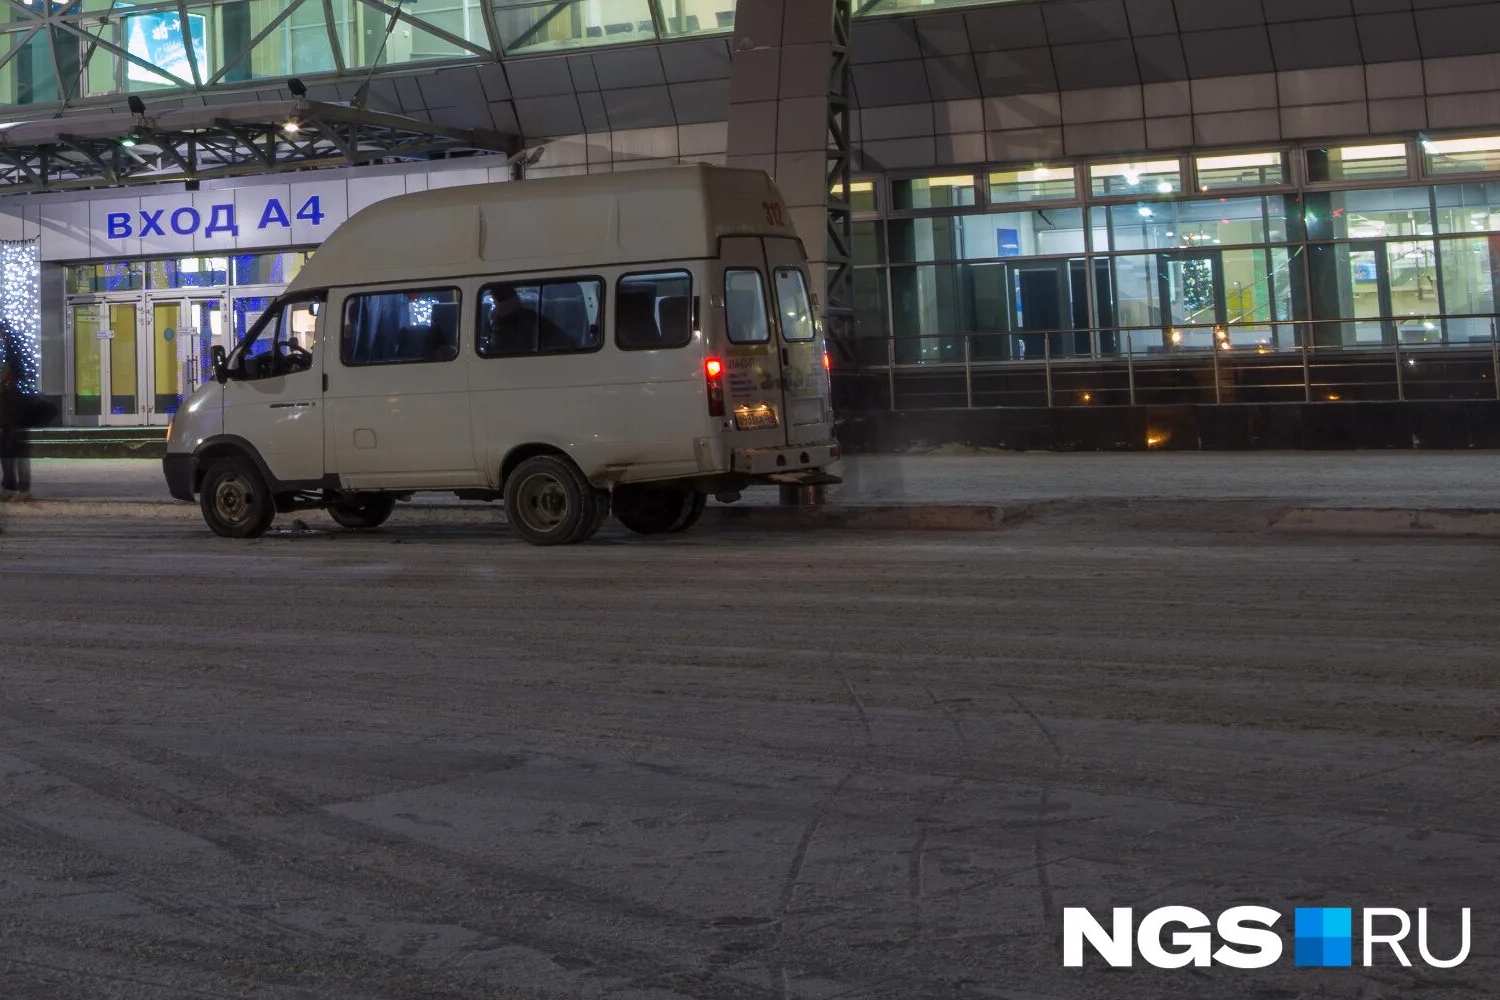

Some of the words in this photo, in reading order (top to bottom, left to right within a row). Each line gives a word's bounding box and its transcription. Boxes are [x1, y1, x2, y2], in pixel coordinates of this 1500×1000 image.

[107, 203, 239, 239] ВХОД
[257, 195, 325, 230] А4
[762, 201, 785, 226] 312
